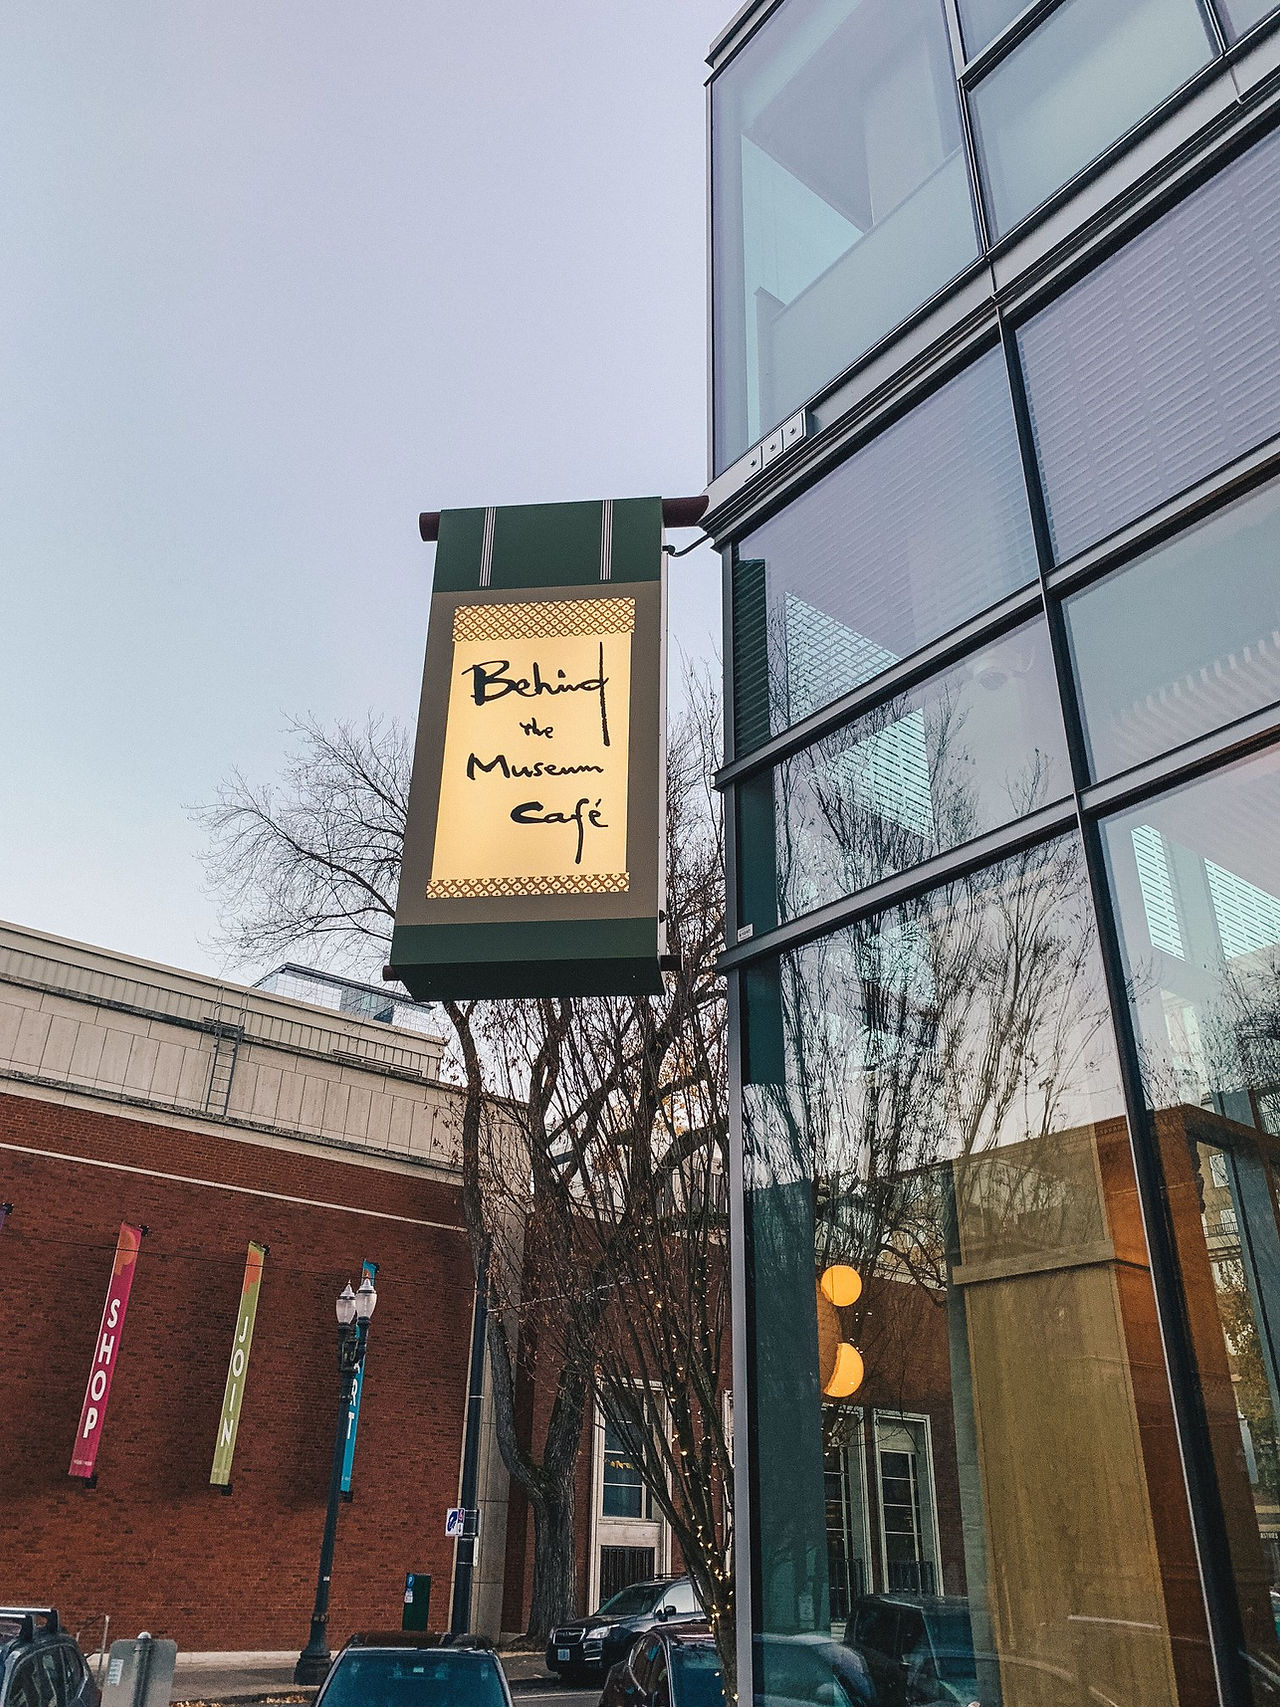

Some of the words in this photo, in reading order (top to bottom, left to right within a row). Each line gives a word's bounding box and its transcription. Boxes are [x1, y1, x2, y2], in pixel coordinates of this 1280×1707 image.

[462, 641, 610, 746] Behind
[519, 717, 554, 739] the
[466, 752, 604, 781] Museum
[510, 797, 609, 865] Café
[83, 1298, 120, 1439] SHOP
[219, 1316, 249, 1448] JOIN
